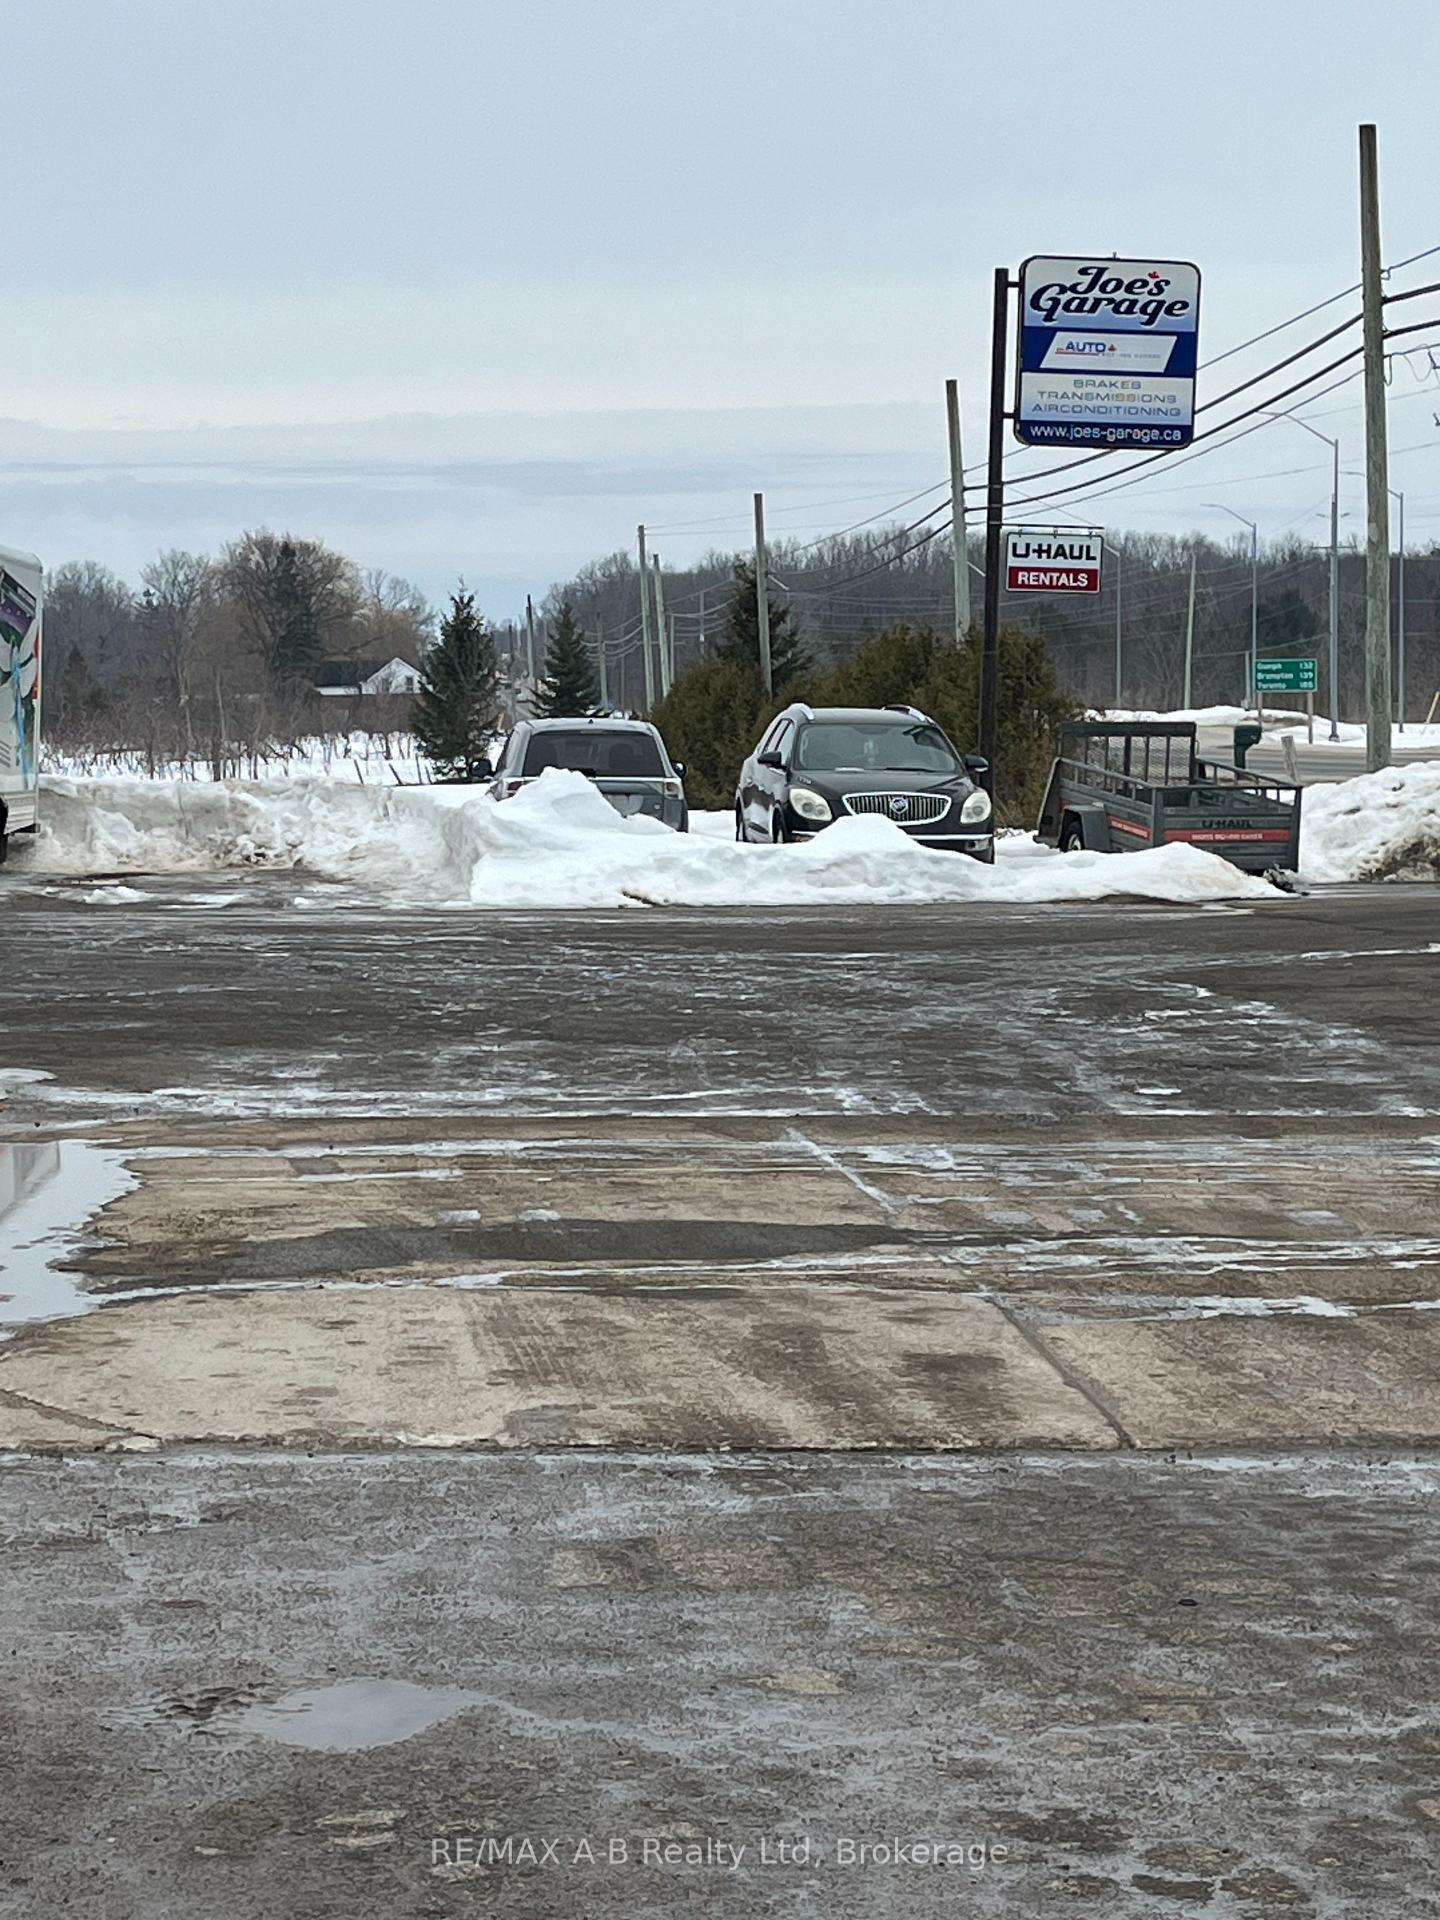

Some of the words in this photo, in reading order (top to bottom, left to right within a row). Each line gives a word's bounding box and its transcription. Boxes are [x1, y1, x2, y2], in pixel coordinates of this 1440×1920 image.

[1030, 282, 1190, 326] Garage
[1065, 341, 1107, 353] AUTO
[1073, 379, 1142, 390] BRAKES
[1037, 390, 1177, 404] TRANSMISSIONS
[1031, 403, 1182, 417] AIRCONDITIONING
[1030, 425, 1182, 442] www.joes-garage.ca
[1012, 542, 1097, 561] U-HAUL
[1017, 571, 1088, 587] RENTALS
